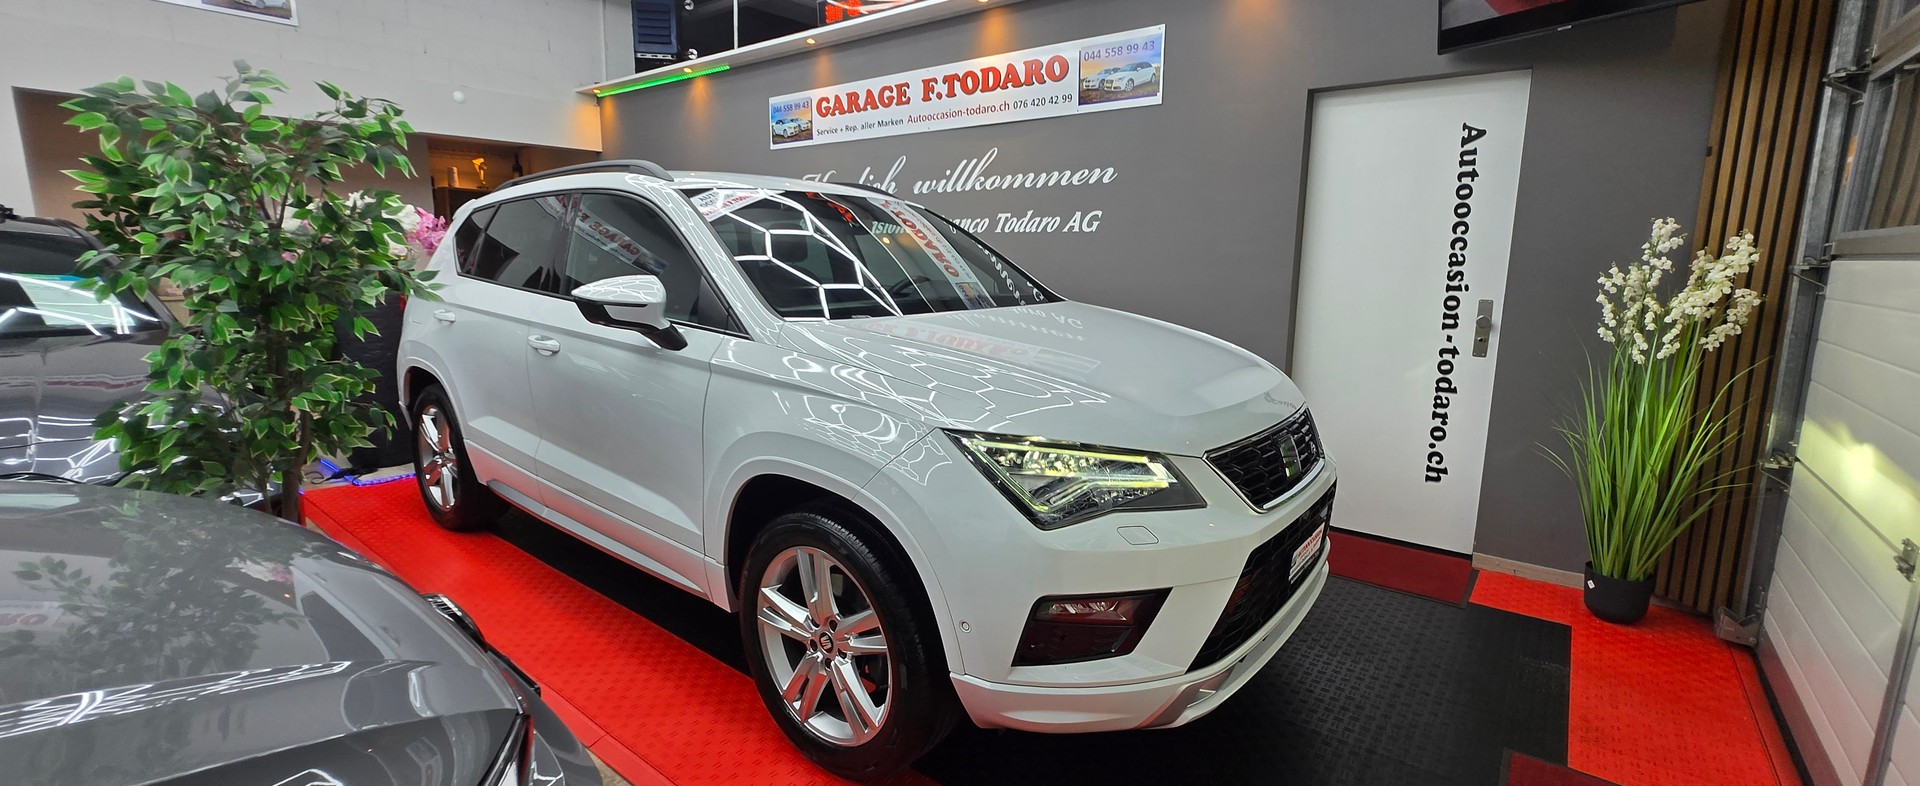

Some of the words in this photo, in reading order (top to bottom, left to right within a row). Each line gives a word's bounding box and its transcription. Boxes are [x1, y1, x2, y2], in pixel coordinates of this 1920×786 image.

[1083, 49, 1102, 62] 044
[1104, 46, 1123, 59] 558
[1126, 43, 1139, 55] 99
[1142, 40, 1155, 52] 43
[815, 82, 911, 118] GARAGE
[921, 54, 1070, 102] F.TODARO
[772, 105, 783, 114] 044
[783, 103, 793, 112] 558
[794, 102, 801, 111] 99
[802, 100, 810, 109] 43
[816, 126, 839, 136] Service
[845, 124, 859, 134] Rep.
[860, 121, 876, 130] aller
[877, 118, 904, 128] Marken
[906, 100, 1010, 125] Autooccasion-todaro.ch
[1013, 98, 1029, 110] 076
[1030, 97, 1046, 108] 420
[1048, 95, 1059, 105] 42
[1061, 93, 1073, 104] 99
[912, 147, 1118, 196] willkommen
[994, 209, 1061, 233] Todaro
[1062, 210, 1103, 233] AG
